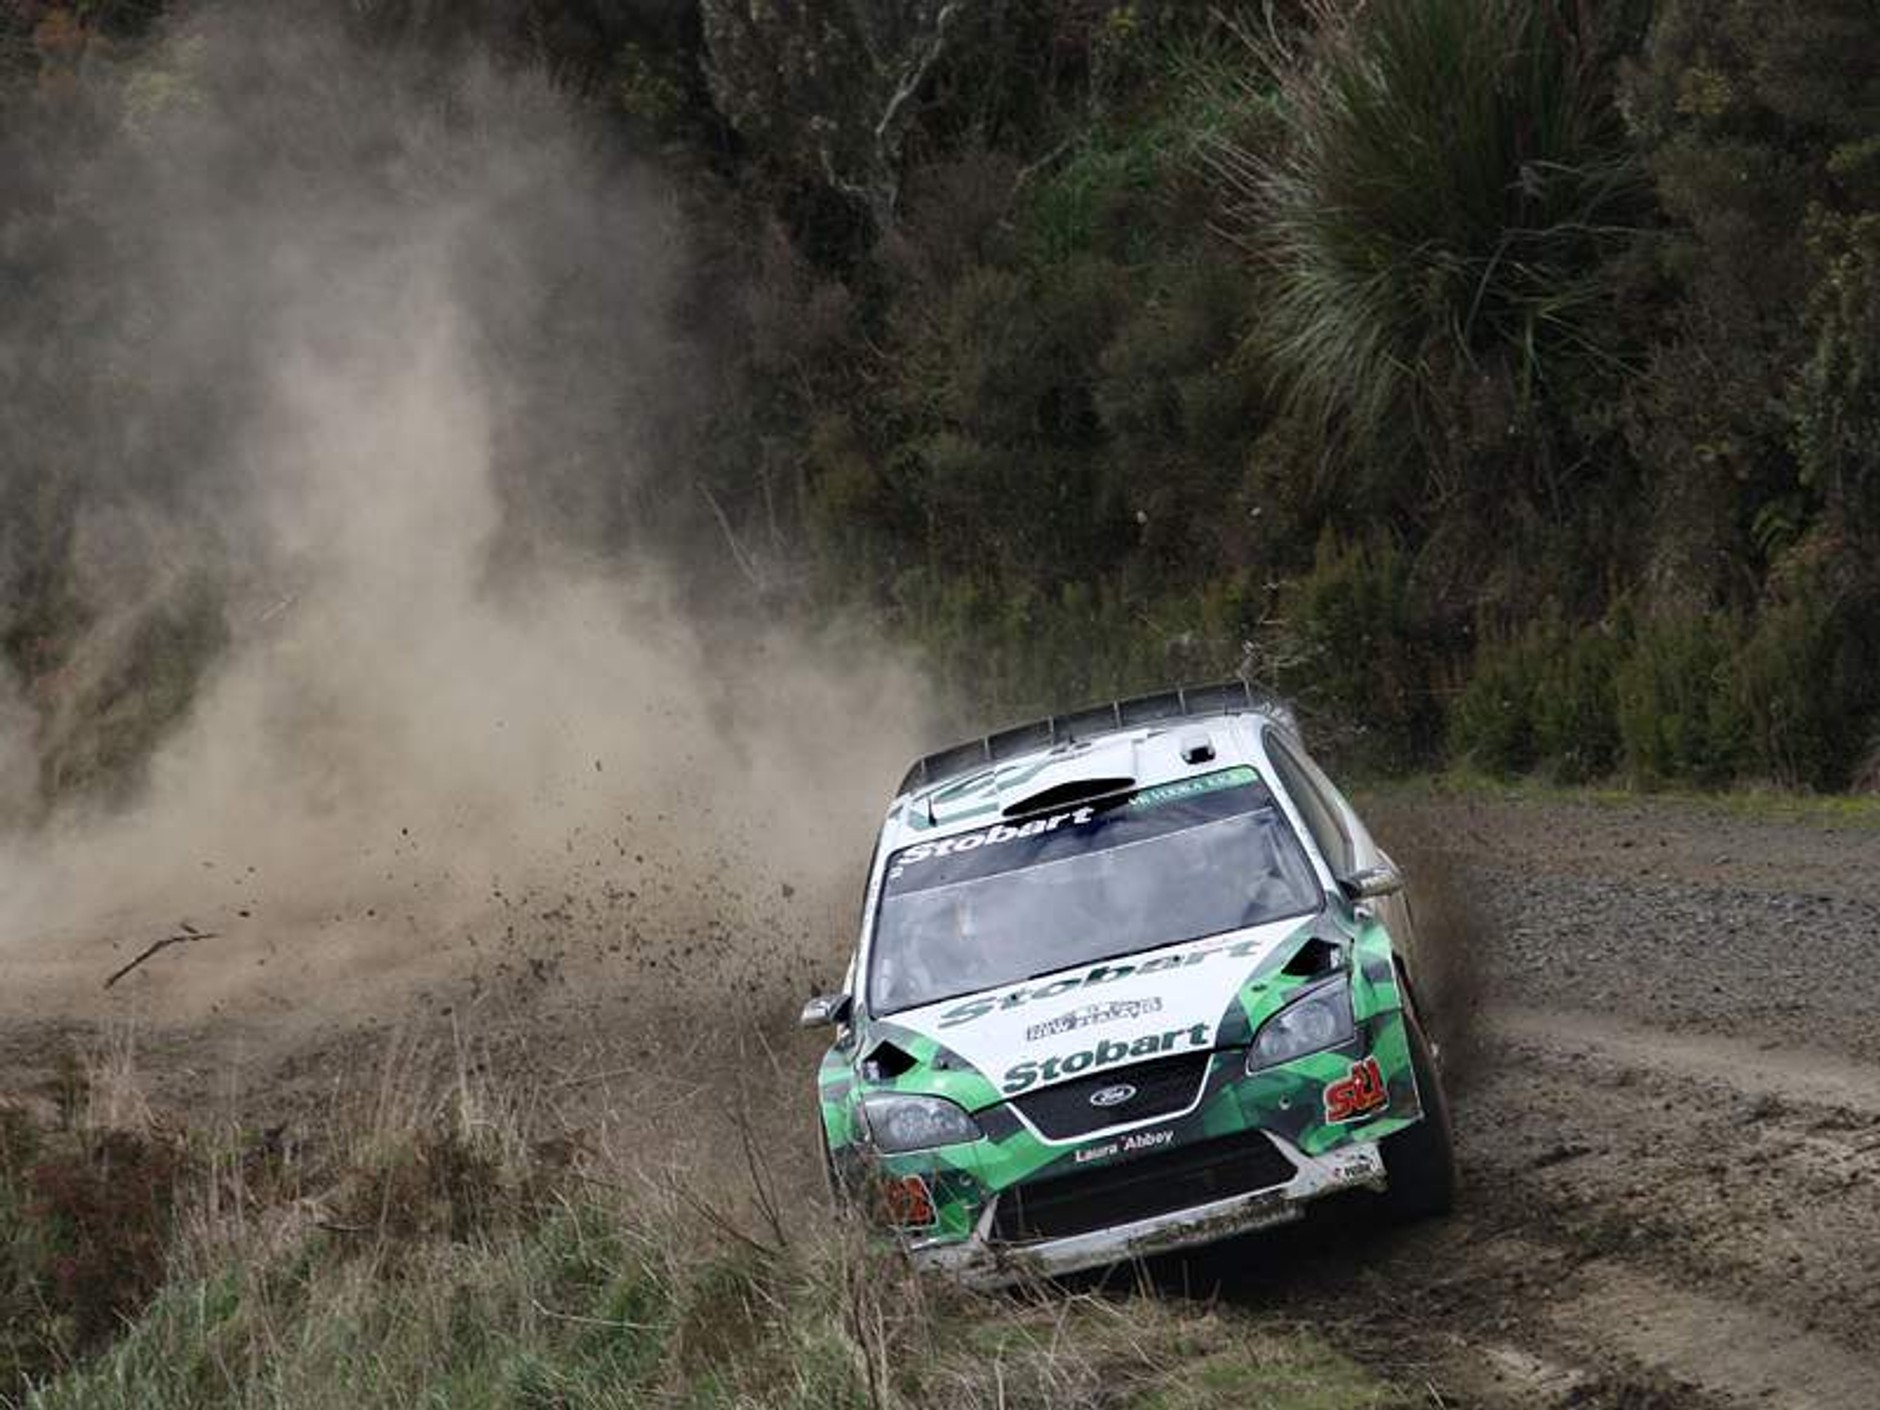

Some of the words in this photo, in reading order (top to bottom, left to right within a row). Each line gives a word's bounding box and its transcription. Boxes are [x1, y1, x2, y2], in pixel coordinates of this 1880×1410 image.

[898, 806, 1096, 865] Stobart
[937, 940, 1263, 1029] Stobart
[1002, 1021, 1211, 1095] Stobart
